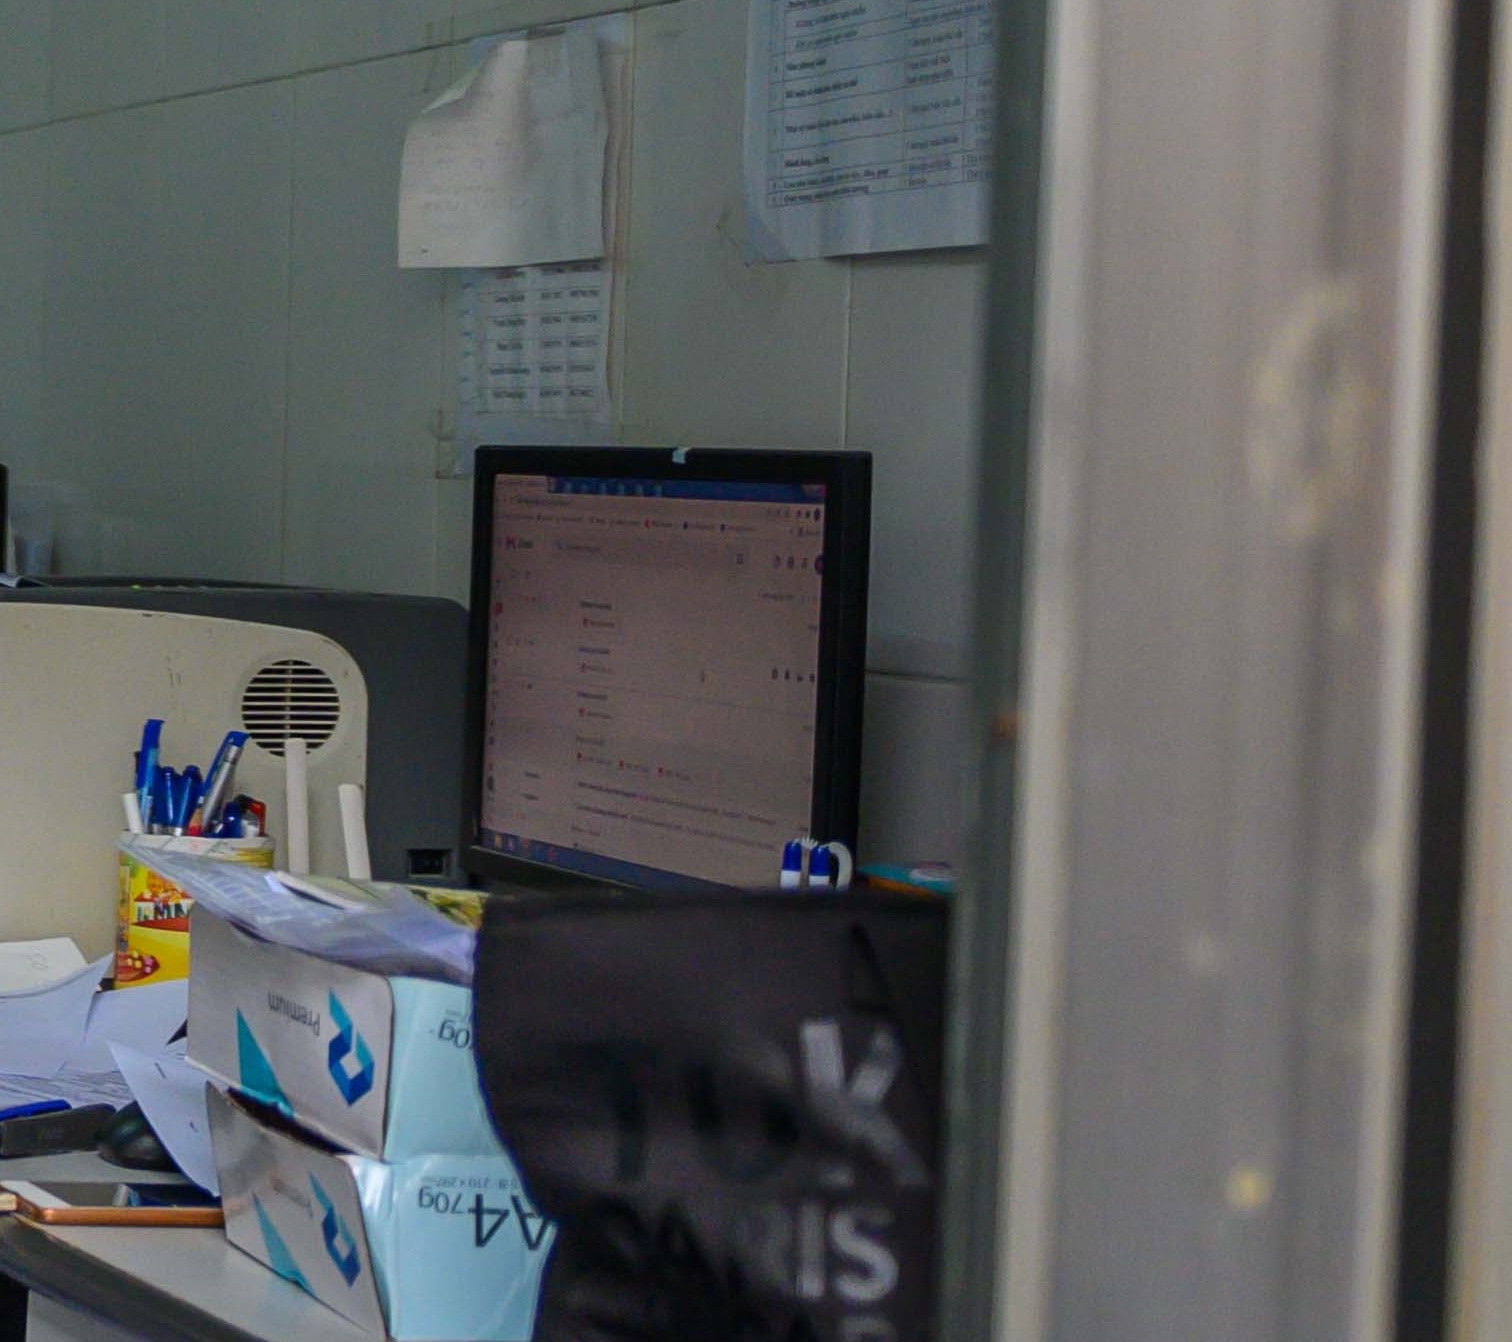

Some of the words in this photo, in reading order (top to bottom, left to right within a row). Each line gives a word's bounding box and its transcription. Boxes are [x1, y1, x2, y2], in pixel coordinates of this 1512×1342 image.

[267, 990, 321, 1038] Premium
[438, 1019, 474, 1051] 0g
[418, 1188, 465, 1216] 70g
[468, 1193, 551, 1252] A4
